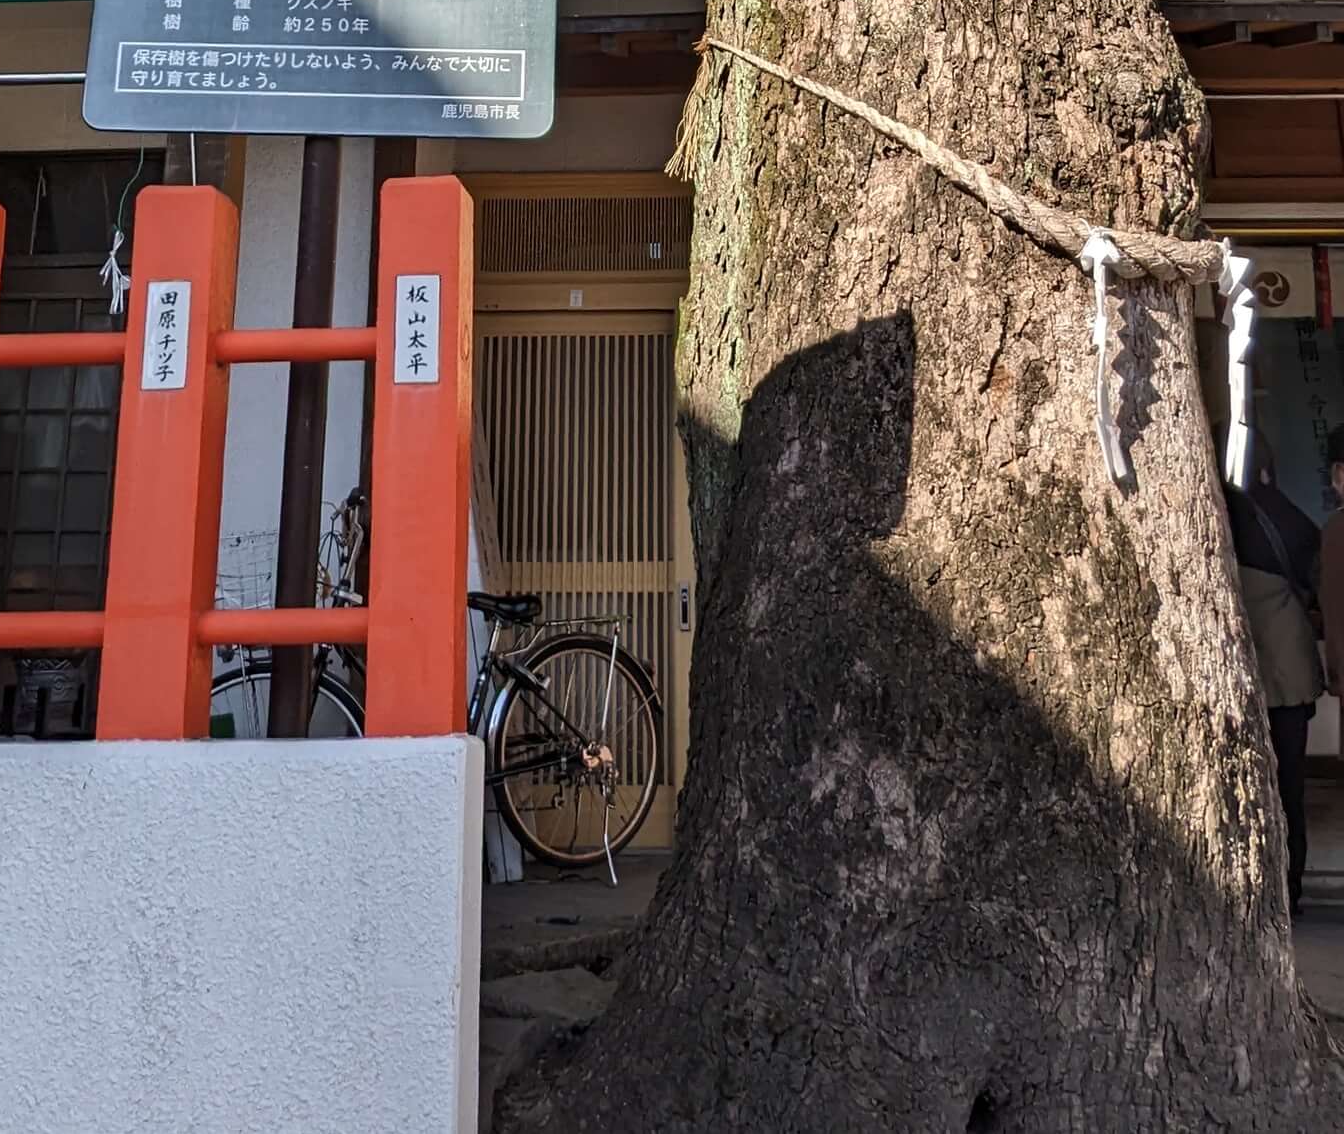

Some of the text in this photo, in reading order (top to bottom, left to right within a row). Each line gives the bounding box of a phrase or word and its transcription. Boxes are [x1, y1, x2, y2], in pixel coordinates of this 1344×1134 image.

[133, 49, 511, 73] 保存樹を傷つけたりしないよう、みんなで大切に
[131, 70, 278, 90] 守り育てましょう。
[441, 104, 521, 120] 鹿児島市長
[406, 284, 430, 375] 板山太平
